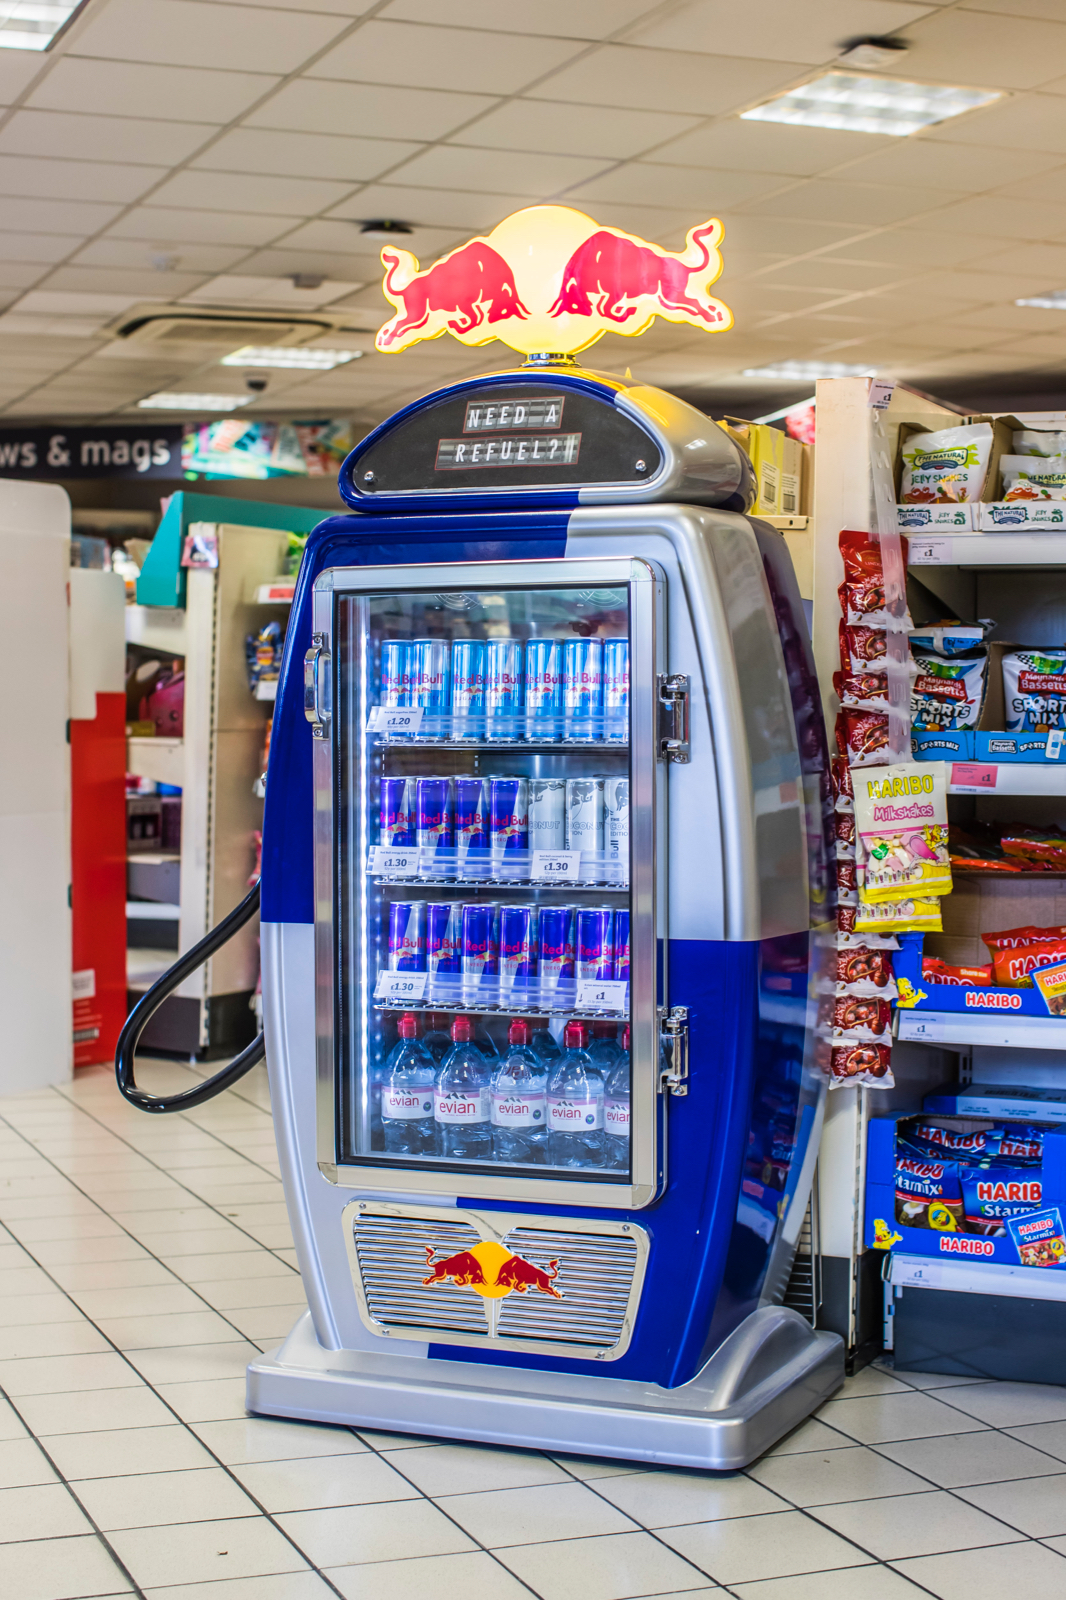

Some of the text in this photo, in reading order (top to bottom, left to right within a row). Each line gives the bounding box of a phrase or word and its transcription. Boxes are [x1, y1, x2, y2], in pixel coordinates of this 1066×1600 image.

[468, 404, 557, 429] NEED A
[47, 434, 70, 468] &
[81, 438, 171, 473] mags
[455, 438, 558, 463] REFUEL?
[422, 673, 442, 684] Bull
[454, 673, 474, 684] Red
[924, 677, 962, 688] Maynards
[918, 681, 965, 697] Bassetts
[1012, 697, 1066, 713] SPORT
[387, 717, 411, 725] £1.20
[922, 712, 952, 727] MIX
[1028, 712, 1058, 726] MIX
[867, 774, 935, 800] HARIBO
[421, 812, 440, 823] Red
[874, 803, 935, 822] Milkshakes
[384, 858, 407, 867] £1.30
[544, 862, 568, 871] £1.30
[402, 937, 422, 948] Bull
[442, 937, 461, 949] Bull
[466, 940, 486, 951] Red
[543, 943, 563, 954] Red
[580, 944, 600, 956] Red
[390, 982, 414, 991] £1.30
[595, 991, 605, 1000] £1
[965, 992, 1022, 1009] HARIBO
[389, 1096, 419, 1106] evian
[439, 1101, 476, 1114] evian
[499, 1104, 529, 1114] evian
[552, 1108, 582, 1118] evian
[896, 1158, 945, 1179] ARIBO
[896, 1174, 940, 1195] tarmix
[977, 1182, 1042, 1202] HARIB
[1018, 1219, 1054, 1236] HARIBO
[940, 1236, 995, 1257] HARIBO
